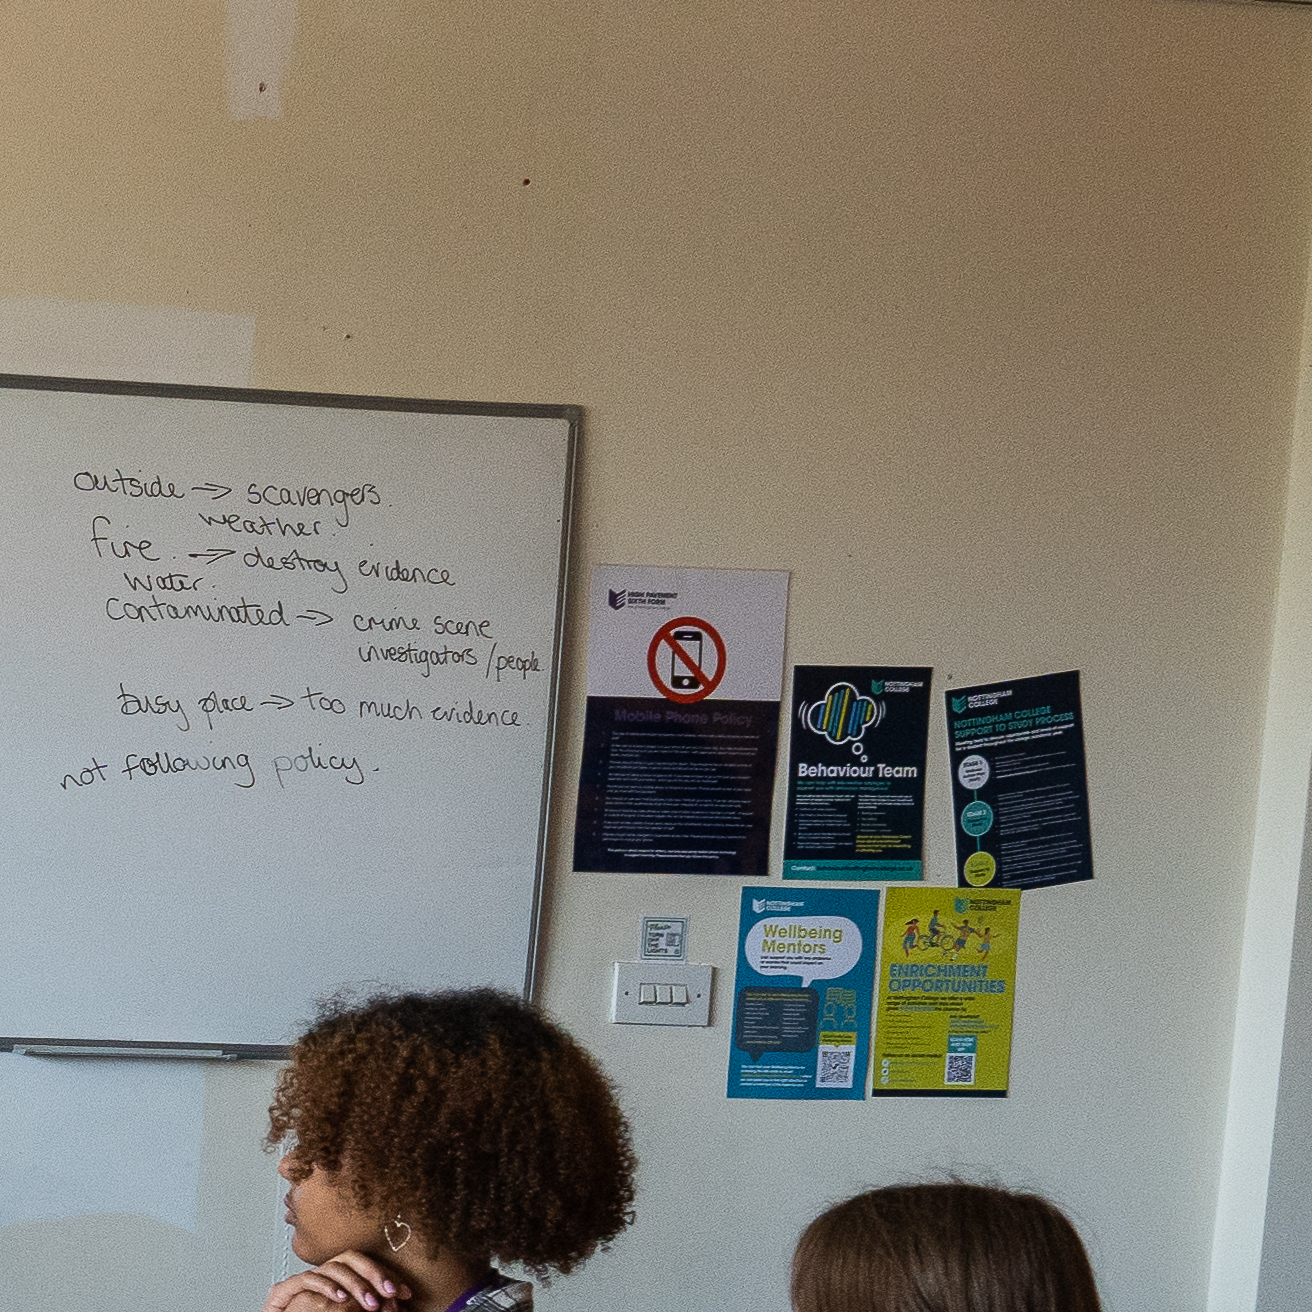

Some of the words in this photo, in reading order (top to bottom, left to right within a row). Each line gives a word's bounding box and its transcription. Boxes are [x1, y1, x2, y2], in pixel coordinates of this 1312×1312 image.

[244, 551, 347, 594] destroy
[358, 543, 456, 586] evidence
[353, 610, 420, 634] crime
[433, 615, 493, 640] scene
[358, 640, 477, 679] investigators
[117, 683, 190, 732] busy
[198, 690, 254, 731] place
[301, 687, 346, 715] too
[359, 697, 422, 722] much
[614, 709, 662, 722] Mobile
[665, 711, 708, 724] Phone
[713, 712, 753, 728] Policy
[954, 712, 1013, 729] NOTTINGHAM
[1014, 706, 1051, 719] COLLEGE
[955, 725, 993, 739] SUPPORT
[995, 723, 1007, 732] TO
[1008, 718, 1034, 730] STUDY
[1036, 712, 1075, 725] PROCESS
[59, 757, 107, 790] not
[121, 742, 254, 788] following
[798, 762, 875, 777] Behaviour
[877, 764, 917, 778] Team
[762, 924, 844, 944] Wellbeing
[761, 938, 827, 954] Mentors
[889, 963, 989, 978] ENRICHMENT
[888, 979, 1007, 994] OPPORTUNITIES
